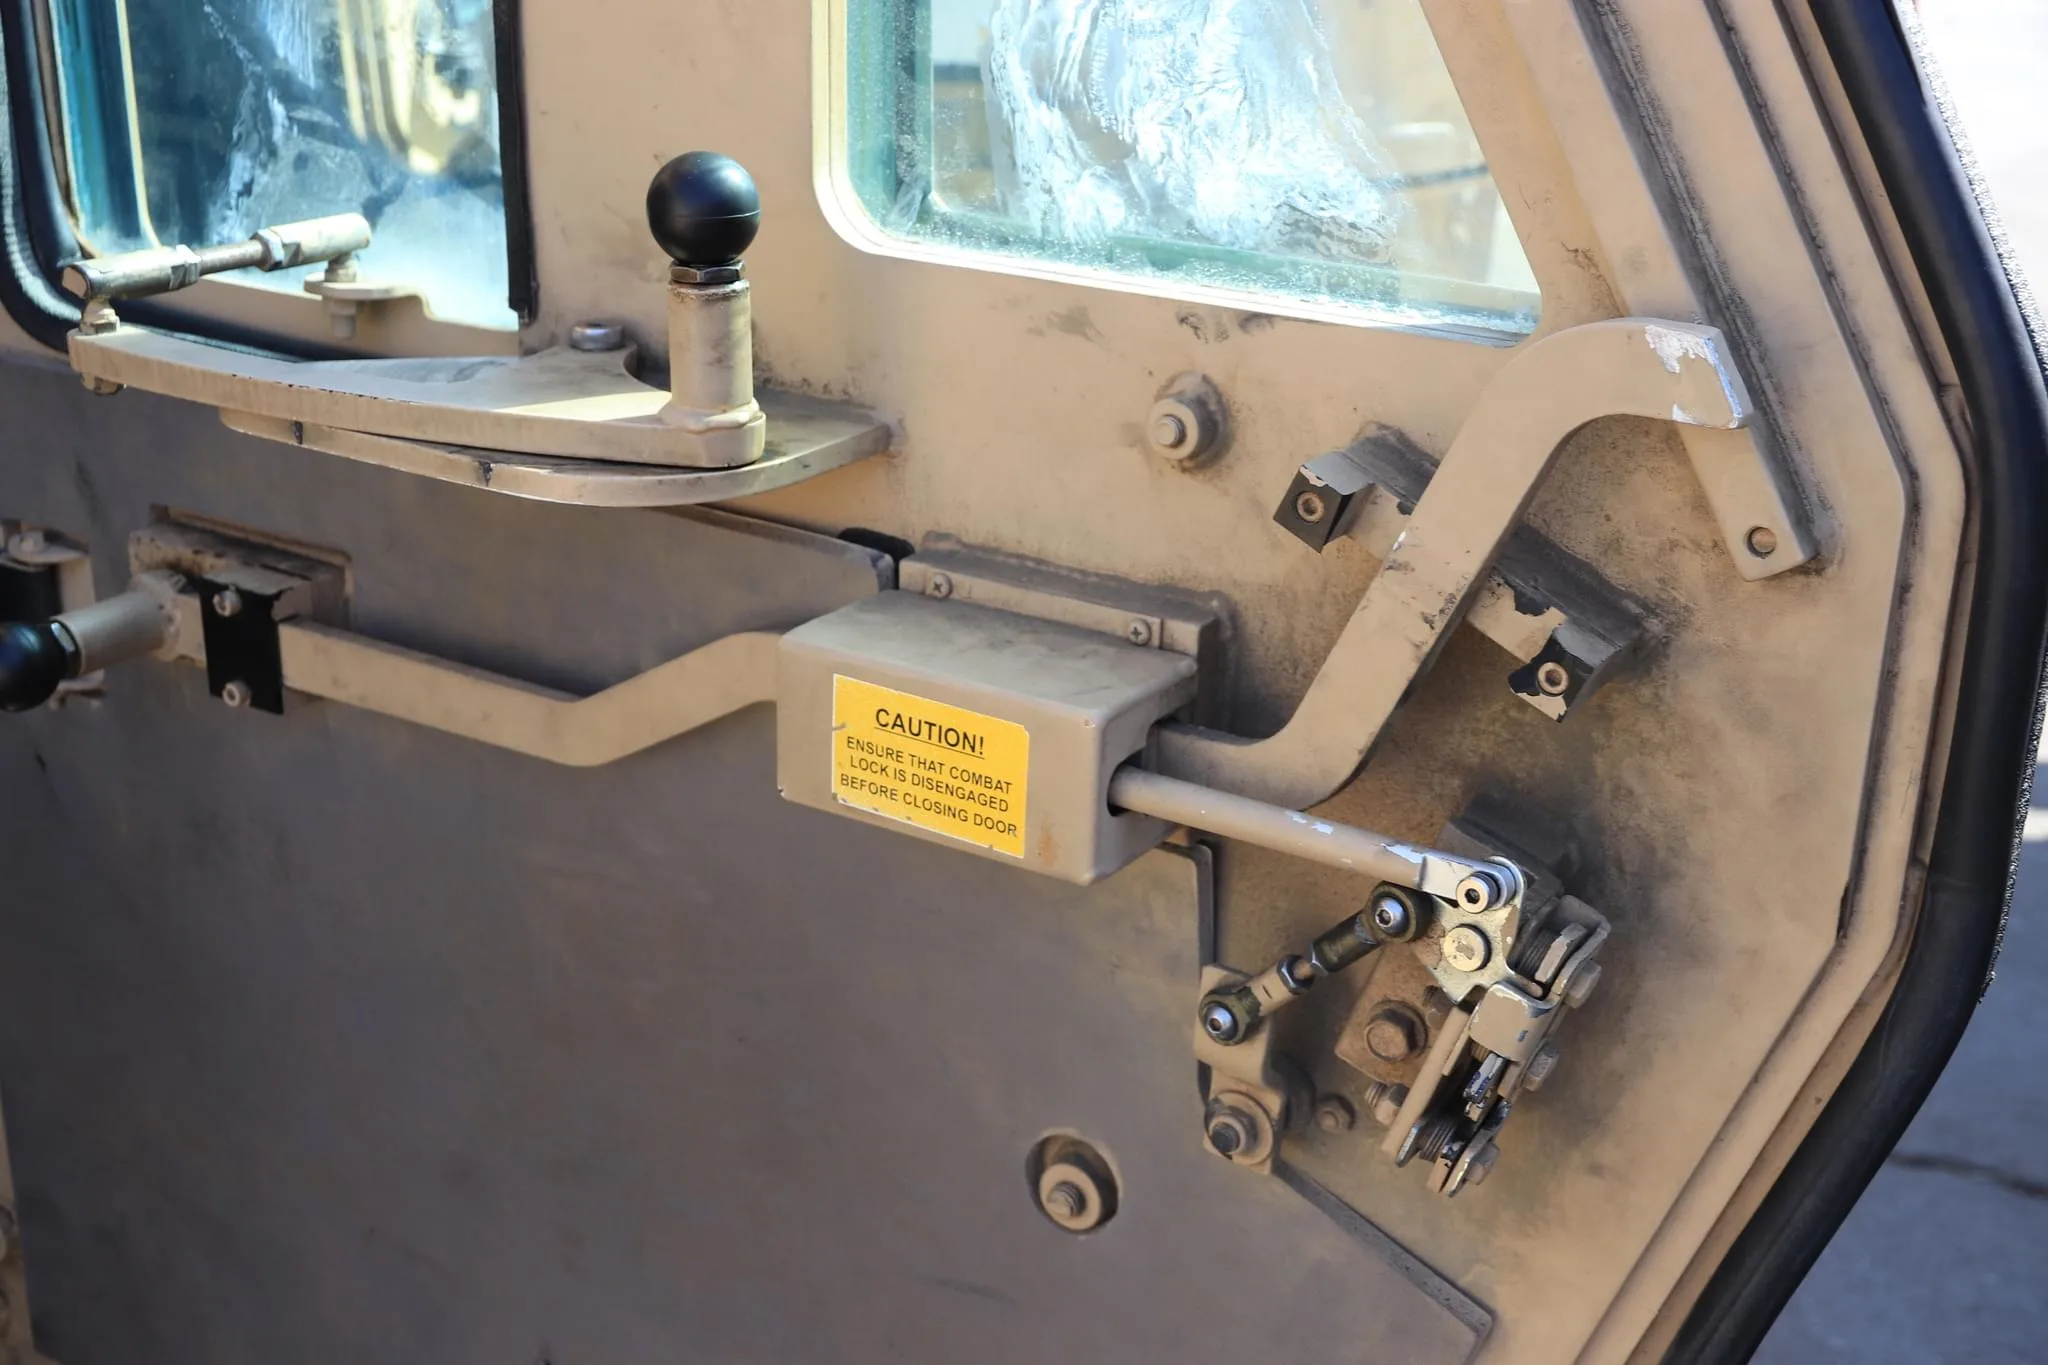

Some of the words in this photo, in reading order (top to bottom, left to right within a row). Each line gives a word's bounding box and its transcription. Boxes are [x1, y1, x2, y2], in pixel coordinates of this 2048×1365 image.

[876, 708, 984, 755] CAUTION!
[847, 736, 904, 763] ENSURE
[908, 753, 945, 775] THAT
[949, 766, 1012, 795] COMBAT
[850, 756, 890, 777] LOCK
[894, 768, 906, 782] IS
[911, 773, 1009, 812] DISENGAGED
[840, 773, 898, 801] BEFORE
[903, 792, 968, 822] CLOSING
[973, 813, 1017, 837] DOOR
